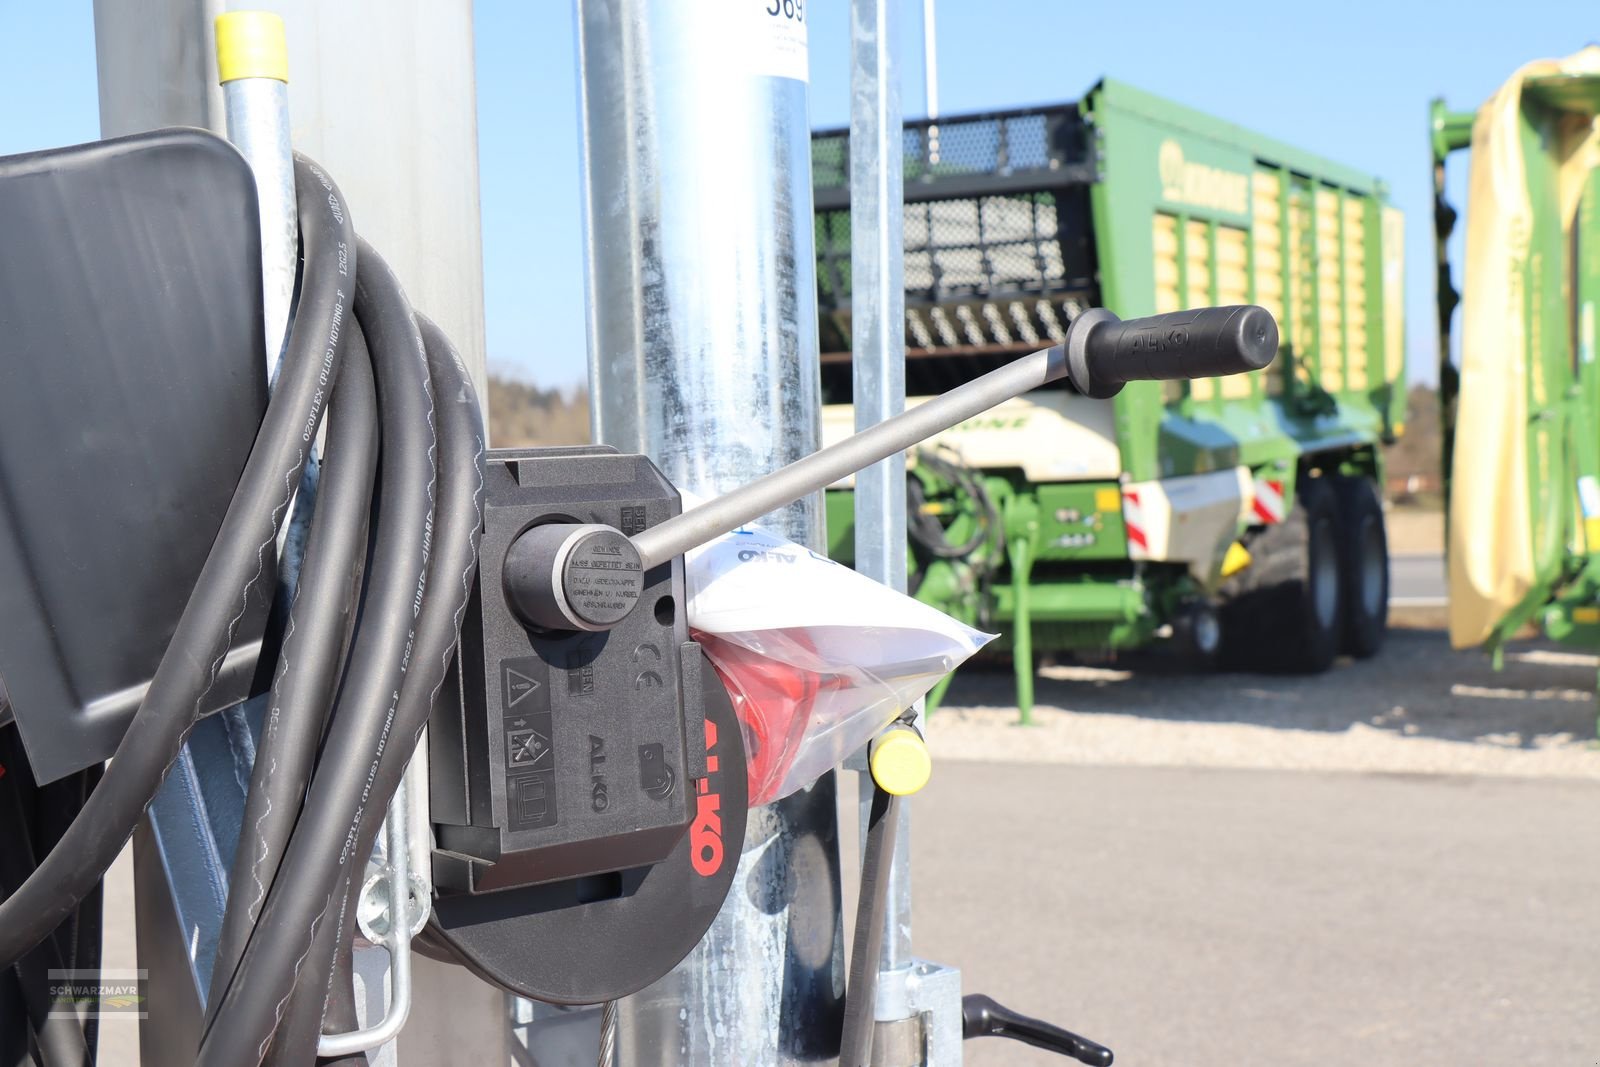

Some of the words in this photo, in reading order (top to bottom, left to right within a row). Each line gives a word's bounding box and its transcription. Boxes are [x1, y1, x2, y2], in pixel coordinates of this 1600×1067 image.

[302, 388, 325, 442] OZOFLEX
[319, 348, 335, 386] (PLUS)
[339, 806, 364, 865] OZOFLEX
[361, 759, 379, 803] (PLUS)
